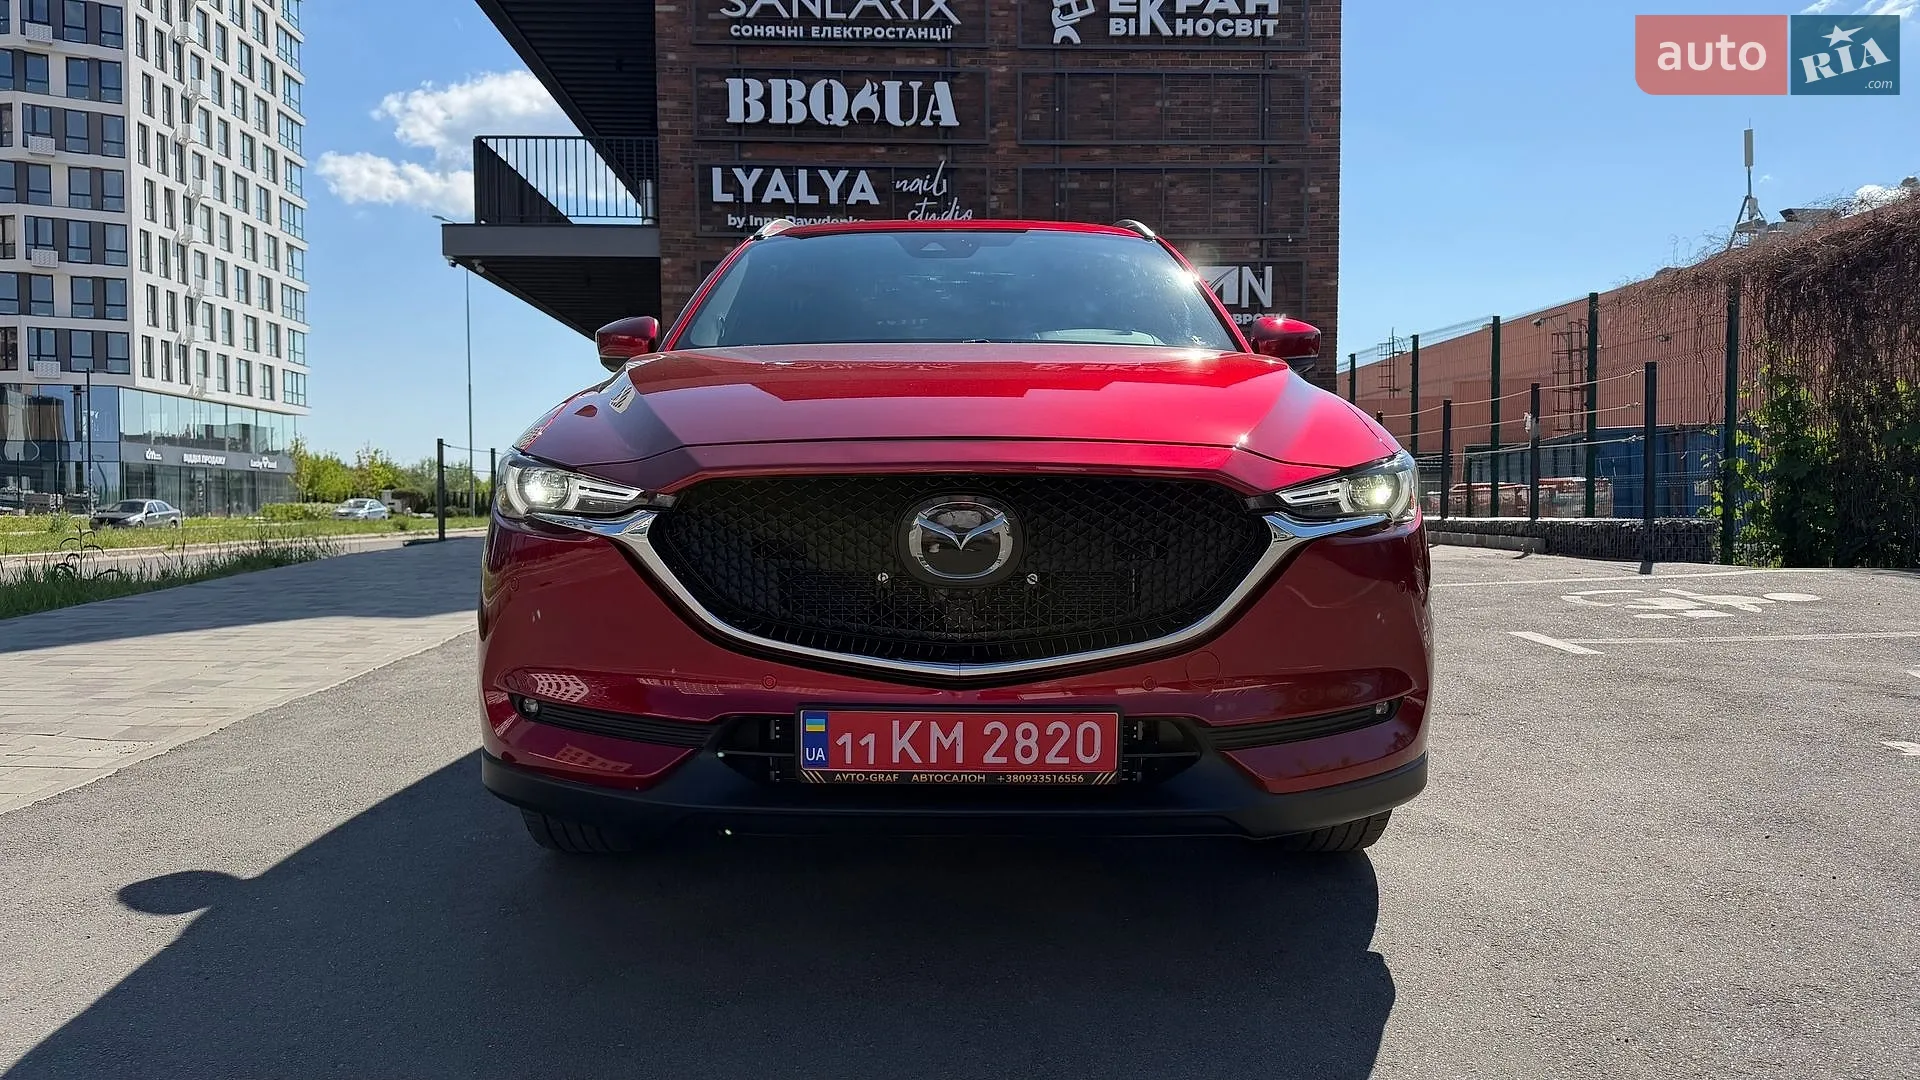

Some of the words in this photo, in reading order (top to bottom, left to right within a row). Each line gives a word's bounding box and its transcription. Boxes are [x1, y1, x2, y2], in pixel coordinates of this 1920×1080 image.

[730, 25, 803, 38] СОНЯЧНІ
[811, 25, 953, 41] ЕЛЕКТРОСТАНЦІЇ
[712, 167, 880, 205] LYALYA
[727, 214, 746, 228] by
[835, 732, 875, 765] 11
[891, 720, 964, 765] KM
[982, 721, 1102, 765] 2820
[805, 747, 826, 761] UA
[834, 773, 899, 783] AVTO-GRAF
[911, 774, 986, 784] АВТОСАЛОН
[996, 774, 1085, 784] +380933516556
